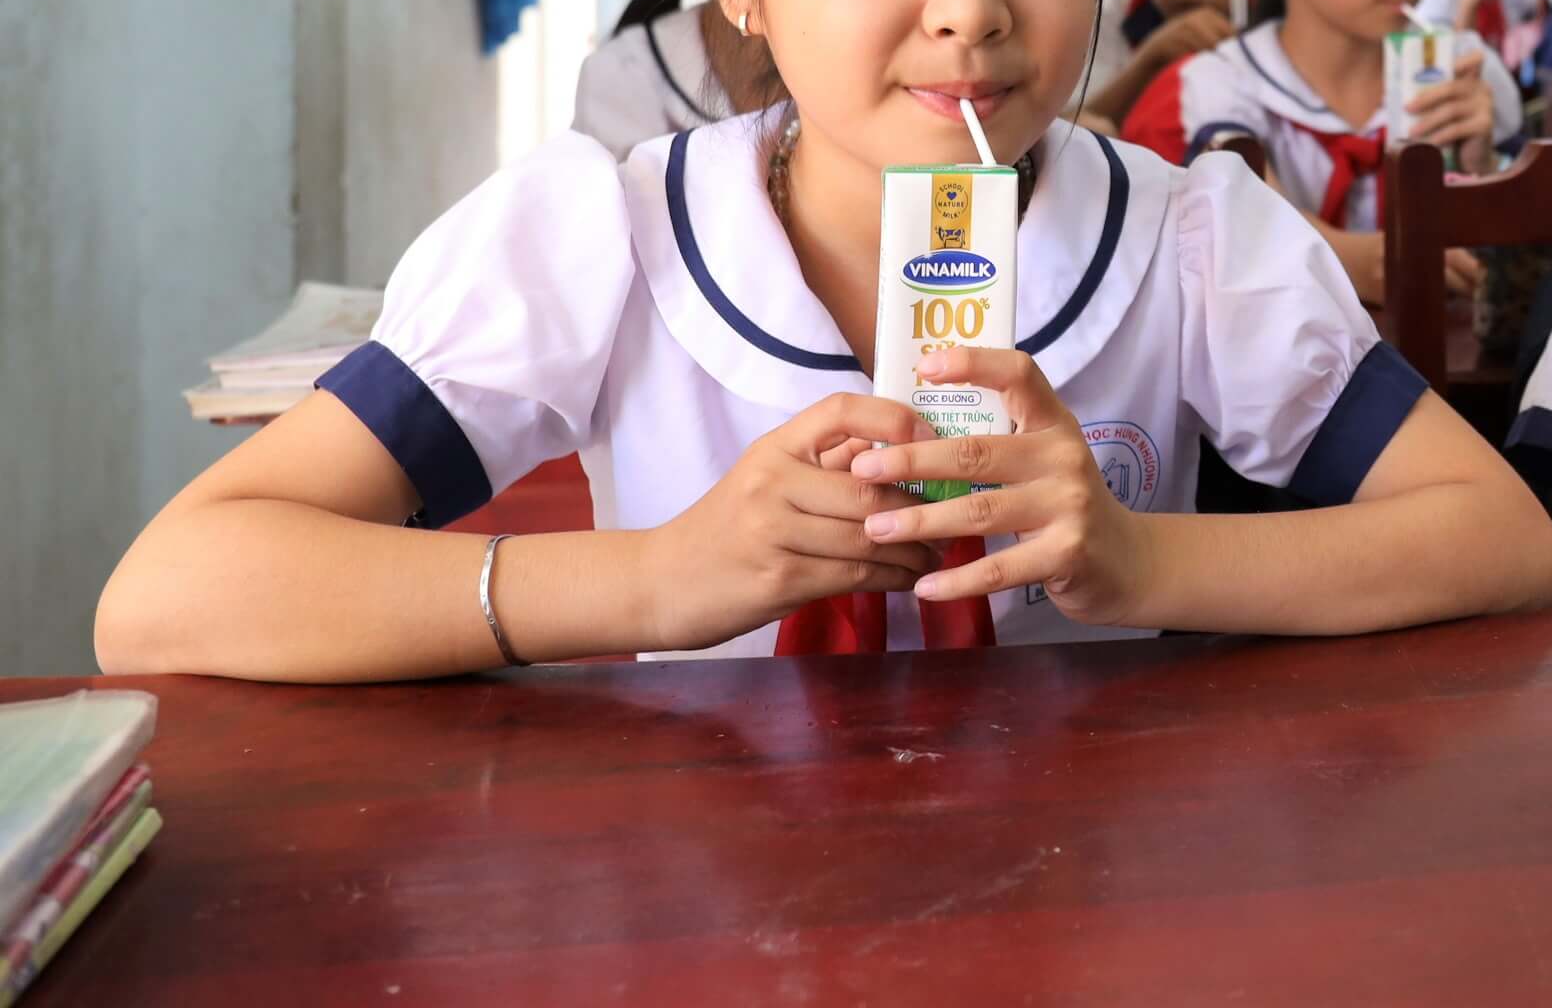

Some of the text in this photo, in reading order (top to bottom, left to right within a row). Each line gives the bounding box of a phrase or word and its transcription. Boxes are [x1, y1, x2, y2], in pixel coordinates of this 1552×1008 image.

[909, 262, 991, 278] VINAMILK
[909, 297, 990, 339] 100%
[919, 393, 975, 404] HỌC ĐƯỜNG
